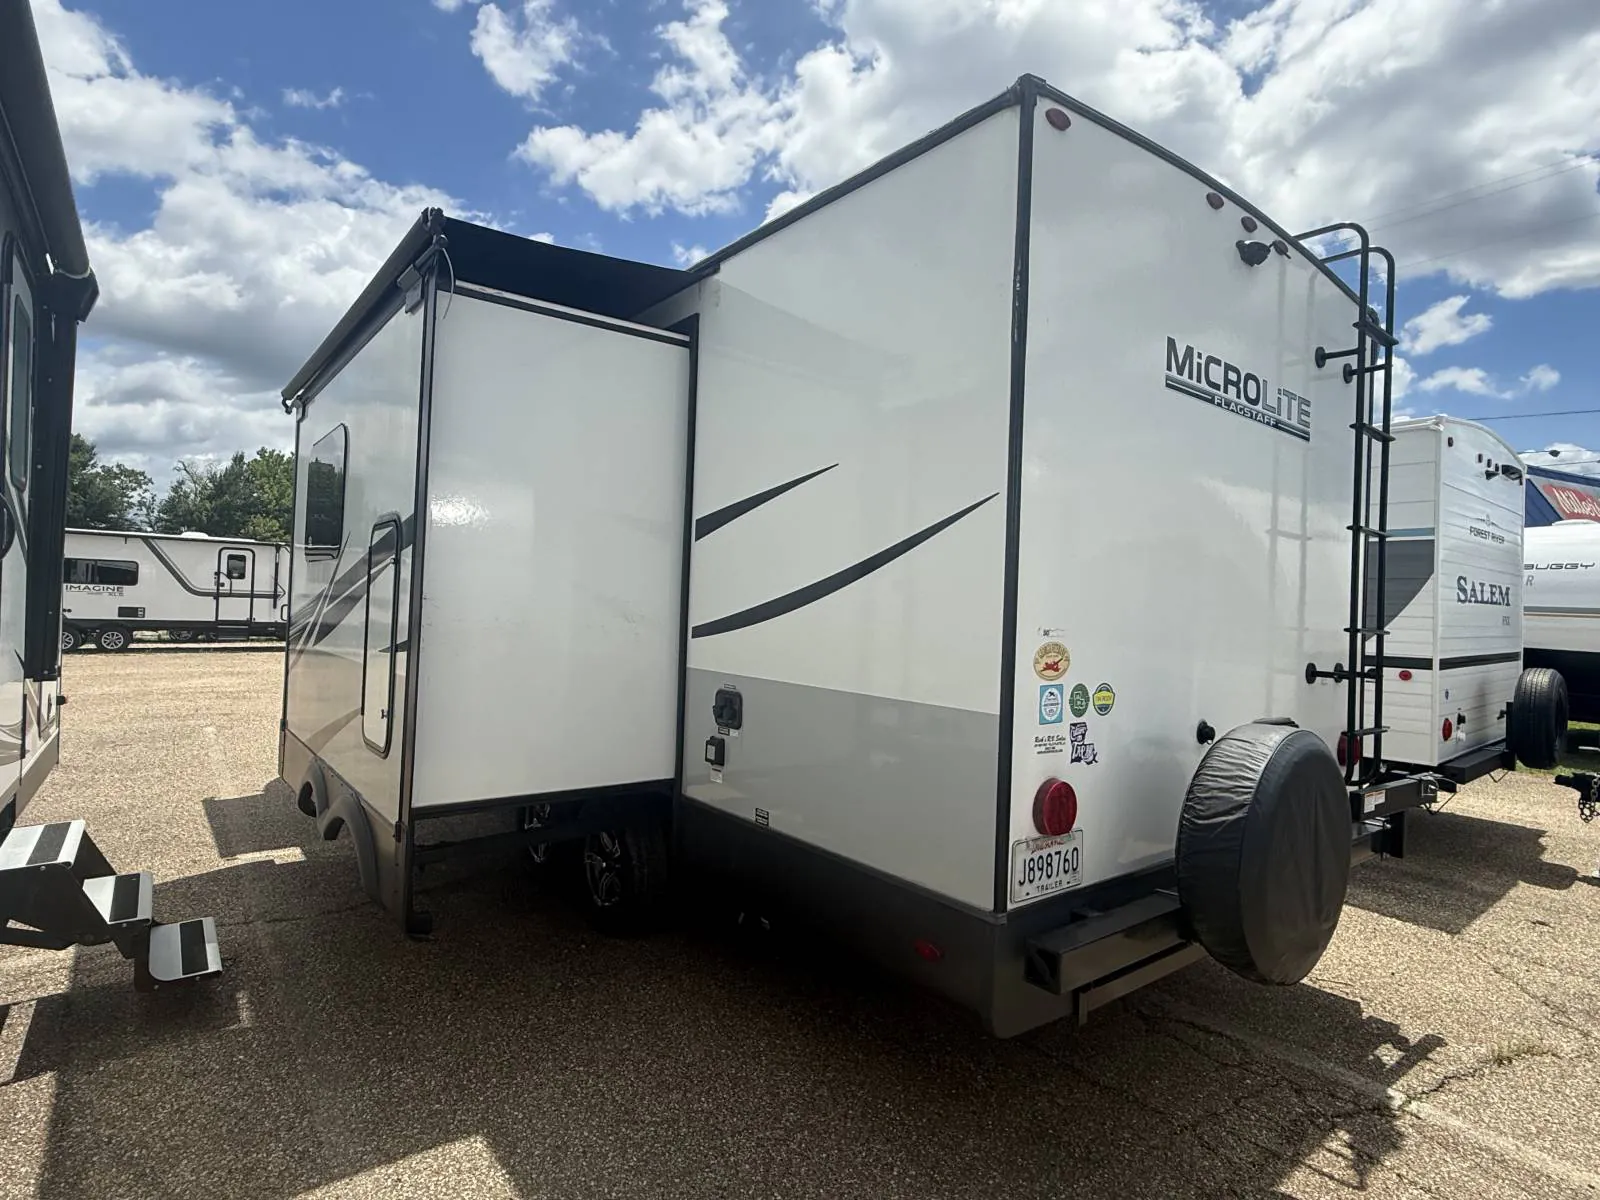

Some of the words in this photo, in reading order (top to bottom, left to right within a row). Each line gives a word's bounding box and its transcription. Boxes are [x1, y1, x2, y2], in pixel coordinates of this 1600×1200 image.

[1213, 396, 1278, 428] FLAGSTAFF
[1469, 525, 1491, 541] FOREST
[1491, 531, 1505, 545] RIVER
[65, 584, 124, 592] IMAGINE
[1457, 575, 1511, 607] SALEM
[1018, 846, 1080, 886] J898760
[1036, 879, 1063, 893] TRAILER
